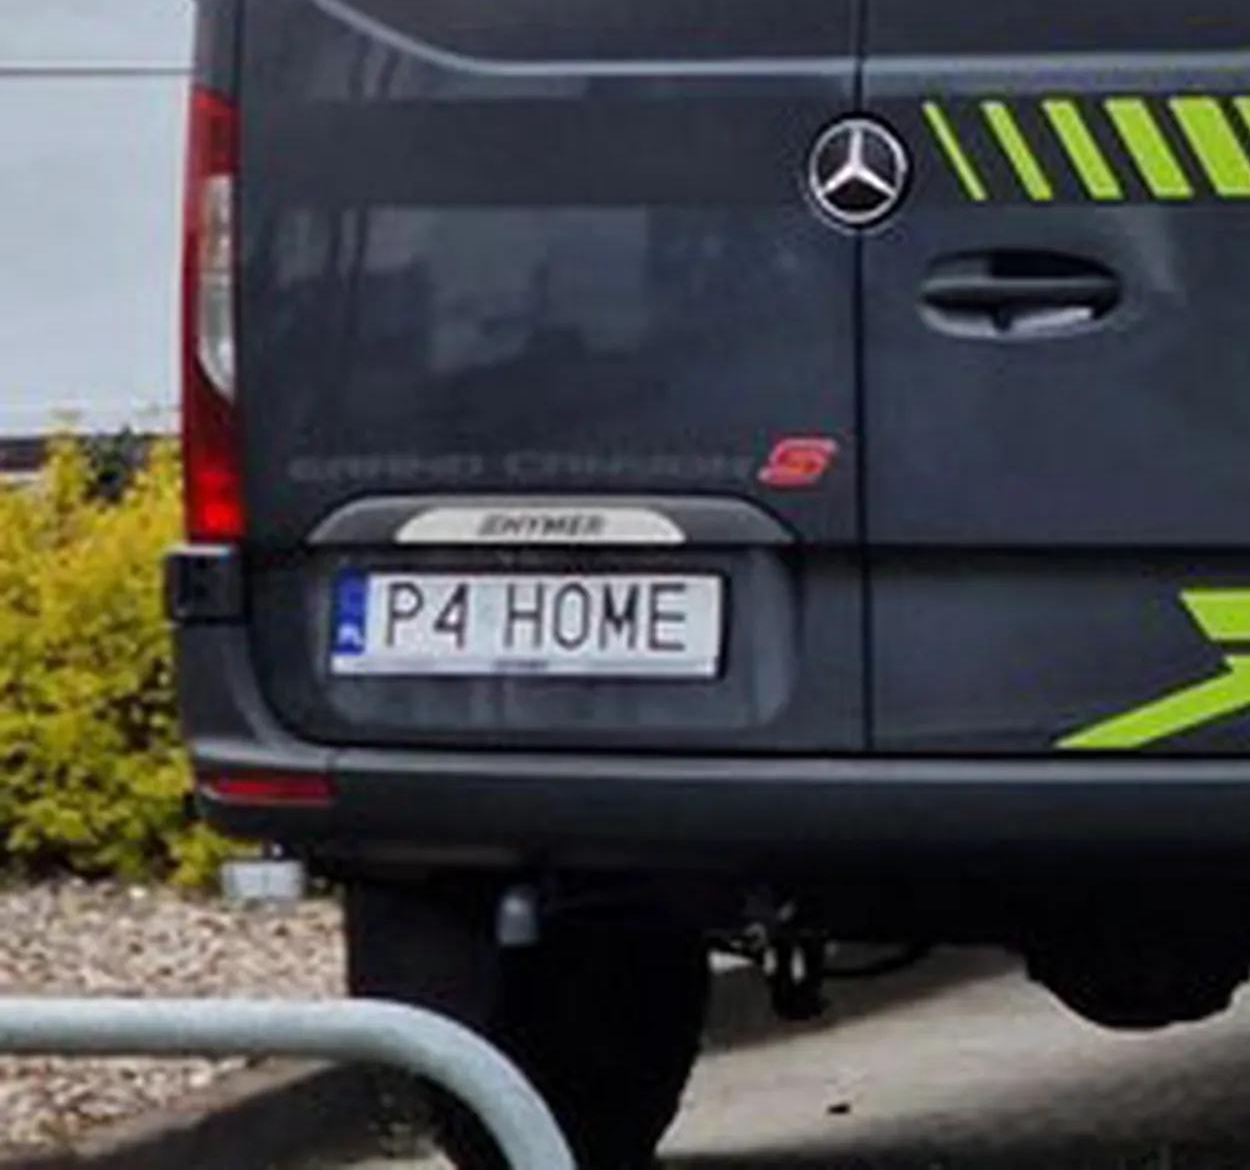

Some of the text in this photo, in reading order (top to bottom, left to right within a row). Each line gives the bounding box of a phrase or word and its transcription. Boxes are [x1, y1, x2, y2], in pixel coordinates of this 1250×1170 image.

[757, 438, 839, 485] S
[384, 581, 692, 653] P4 HOME
